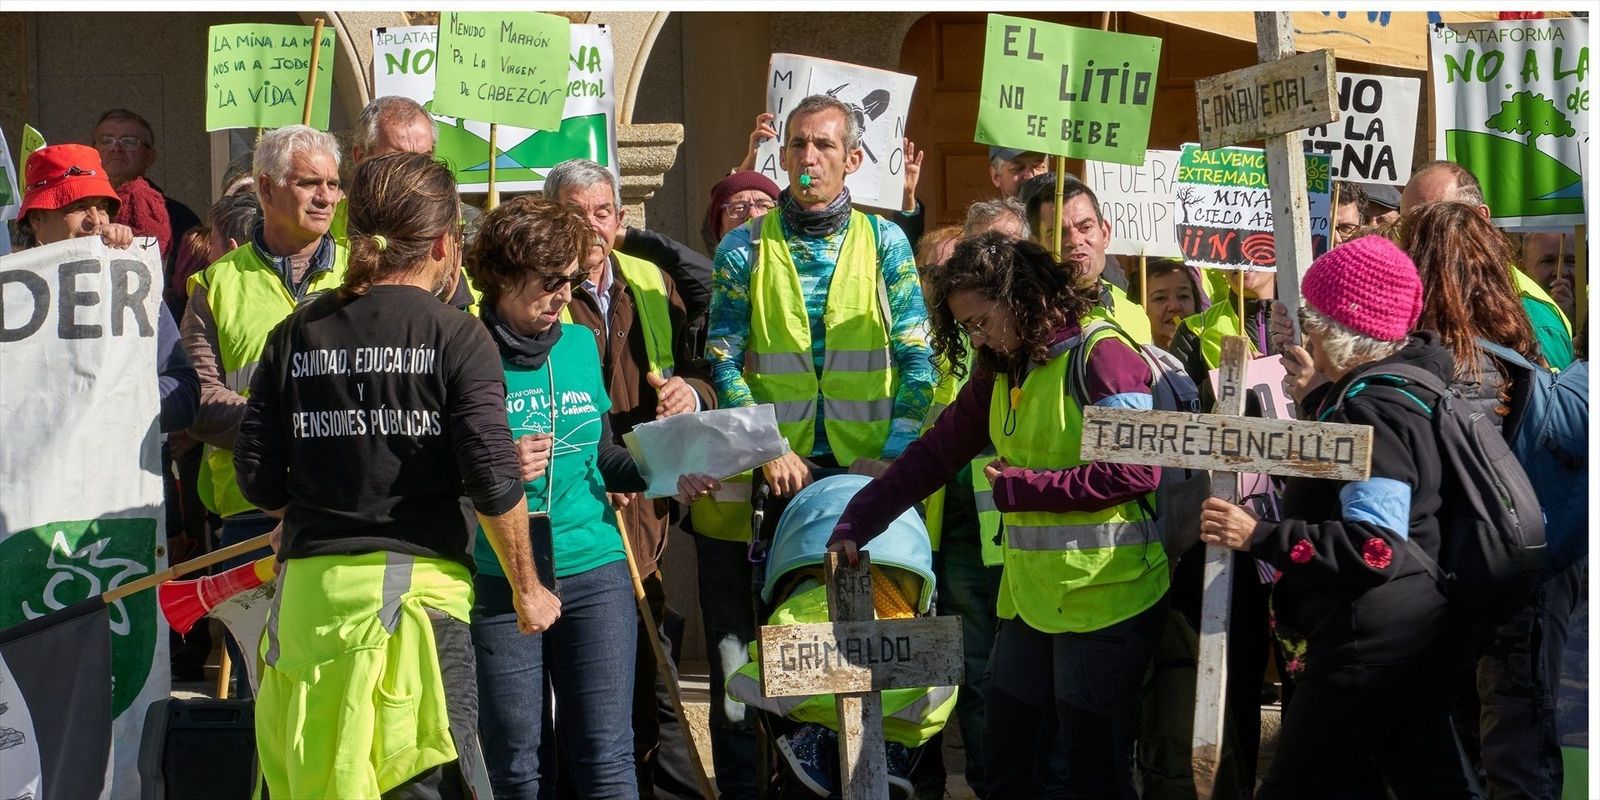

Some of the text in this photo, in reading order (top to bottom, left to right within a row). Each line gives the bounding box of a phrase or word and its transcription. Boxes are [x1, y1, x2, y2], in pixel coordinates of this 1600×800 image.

[385, 32, 437, 45] PLATAF
[450, 12, 550, 48] MENUDO MARRÓN
[1444, 27, 1565, 44] PLATAFORMA
[214, 35, 232, 52] LA
[281, 37, 298, 47] LA
[1003, 25, 1044, 61] EL
[213, 61, 230, 77] NOS
[234, 60, 246, 71] VA
[252, 60, 262, 70] A
[385, 48, 436, 75] NO
[473, 53, 486, 69] LA
[500, 56, 537, 76] VIRGEN
[1444, 49, 1504, 83] NO
[1520, 49, 1539, 83] A
[460, 80, 562, 105] DE CABEZÓN
[1000, 84, 1024, 110] NO
[1201, 76, 1313, 132] CAÑAVERAL
[1027, 115, 1120, 148] SE BEBE
[1345, 116, 1384, 142] LA
[1192, 149, 1266, 168] SALVEMO
[1303, 140, 1398, 181] INA
[1194, 208, 1242, 224] CIELO
[292, 344, 435, 378] SANIDAD, EDUCACIÓN
[357, 383, 364, 401] Y
[505, 388, 544, 401] ATAFORMA
[531, 396, 539, 410] A
[293, 404, 442, 438] PENSIONES PÚBLICAS
